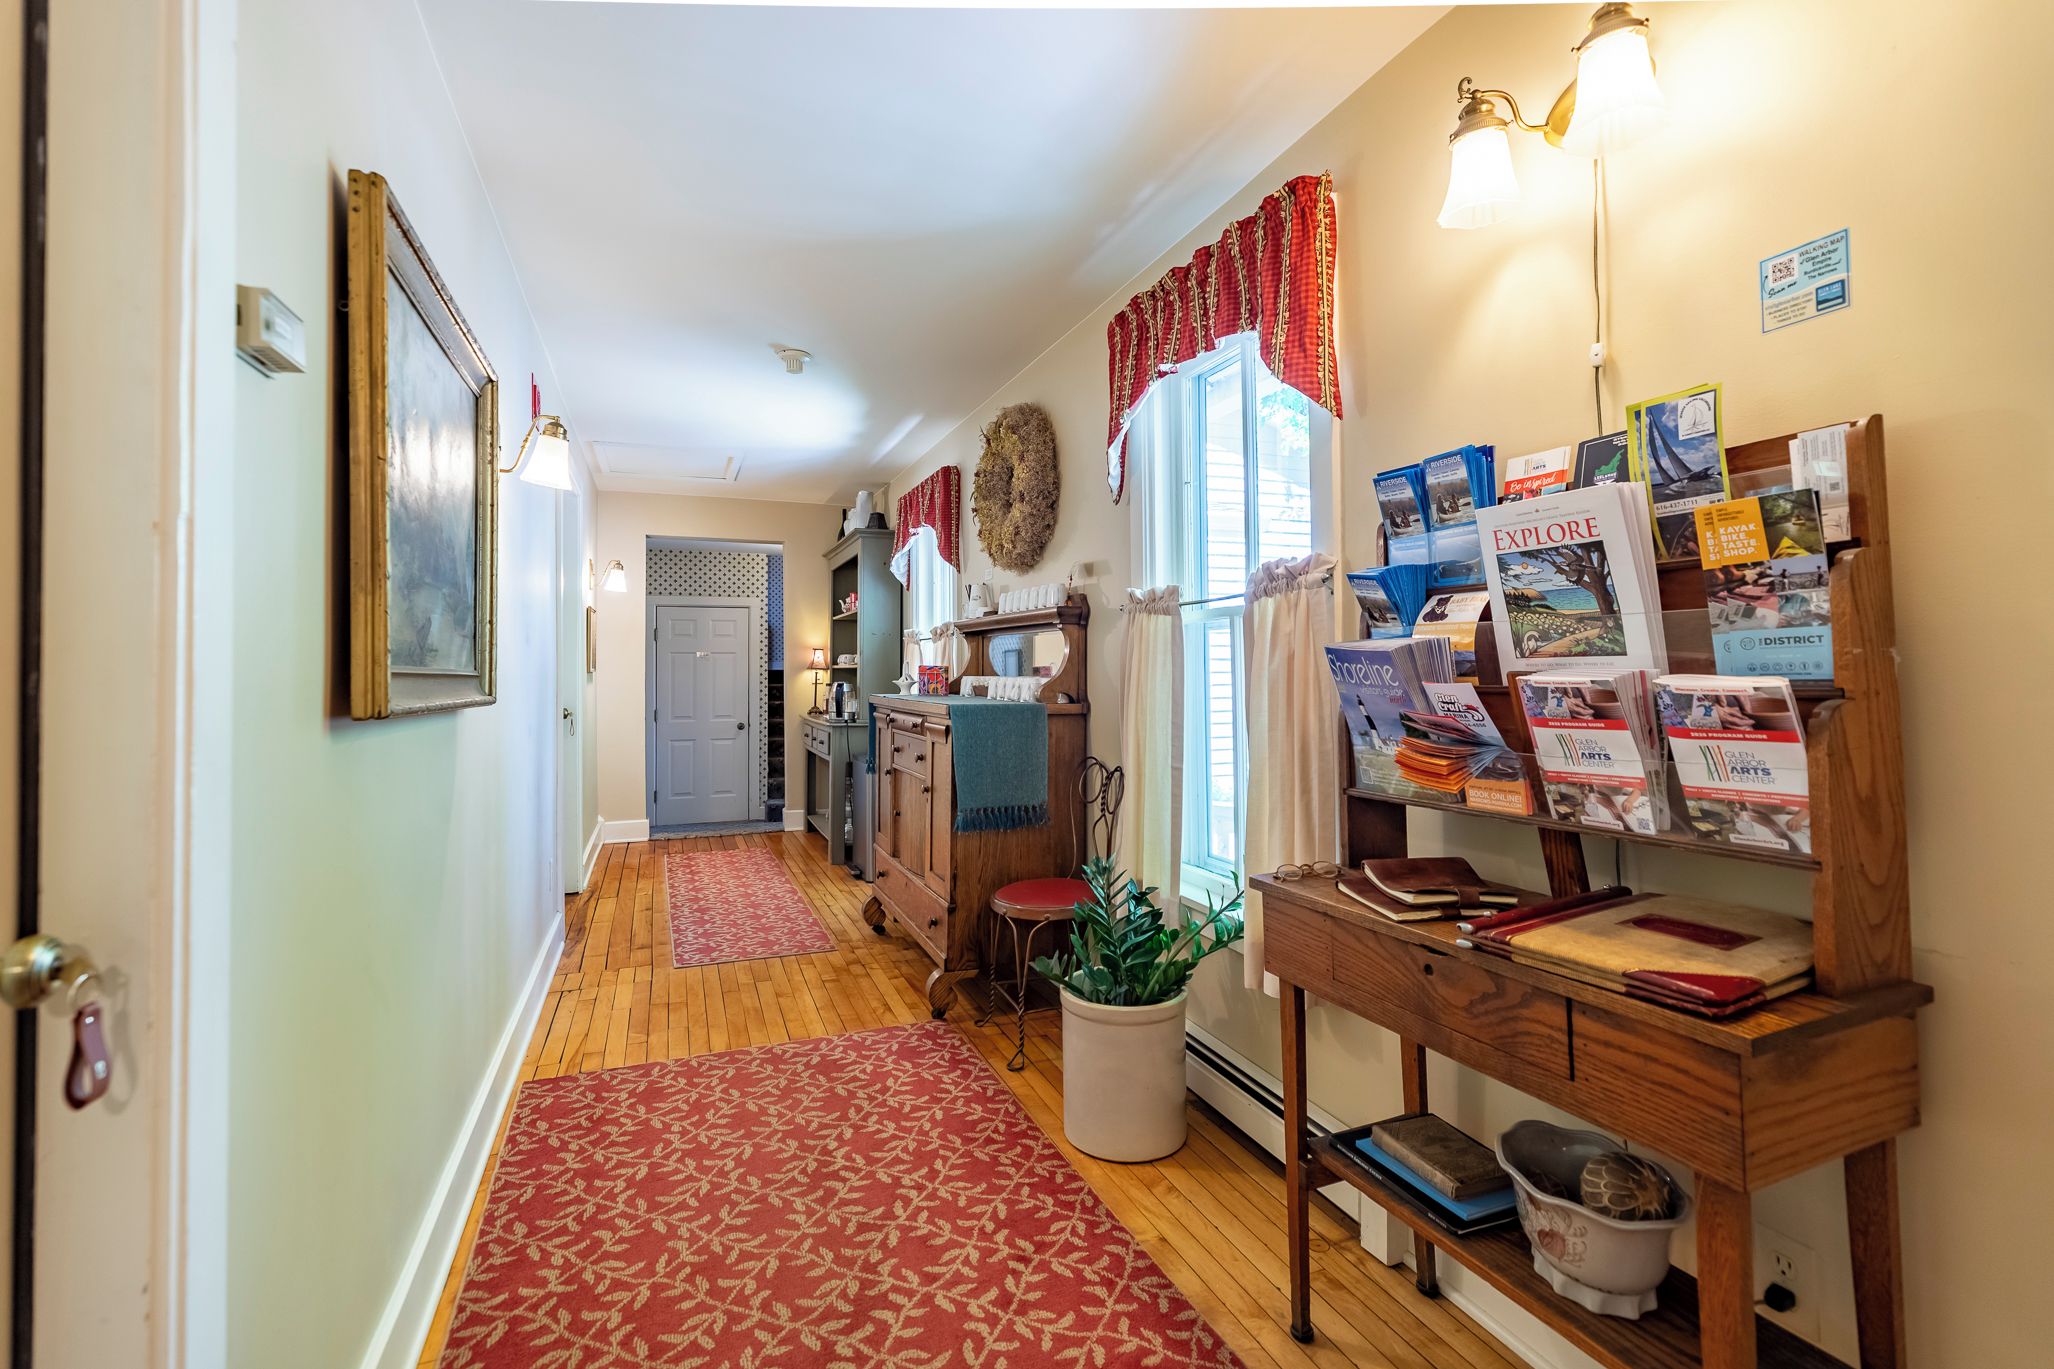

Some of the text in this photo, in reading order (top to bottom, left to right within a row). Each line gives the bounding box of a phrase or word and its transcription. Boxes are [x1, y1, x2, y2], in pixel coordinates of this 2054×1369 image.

[1799, 235, 1845, 257] WALKING MAP
[1805, 247, 1839, 263] Glen Arbor
[1812, 256, 1832, 267] Empire
[1767, 280, 1798, 299] Scan me
[1430, 454, 1462, 469] RIVERSIDE
[1380, 476, 1408, 487] RIVERSIDE
[1510, 472, 1557, 493] Be inspired
[1493, 517, 1601, 552] EXPLORE
[1719, 523, 1760, 535] KAYAK.
[1722, 539, 1760, 550] TASTE.
[1723, 548, 1758, 558] SHOP.
[1764, 635, 1824, 646] DISTRICT
[1327, 653, 1399, 686] Shoreline
[1434, 692, 1458, 703] Glen
[1437, 701, 1464, 713] Craft
[1575, 738, 1598, 748] GLEN
[1578, 745, 1607, 753] ARBOR
[1580, 751, 1612, 761] ARTS
[1725, 750, 1755, 760] GLEN
[1582, 760, 1615, 768] CENTER
[1727, 758, 1767, 768] ARBOR
[1730, 766, 1772, 776] ARTS
[1731, 774, 1776, 785] CENTER
[1469, 789, 1490, 800] BOOK
[1491, 792, 1522, 804] ONLINE!
